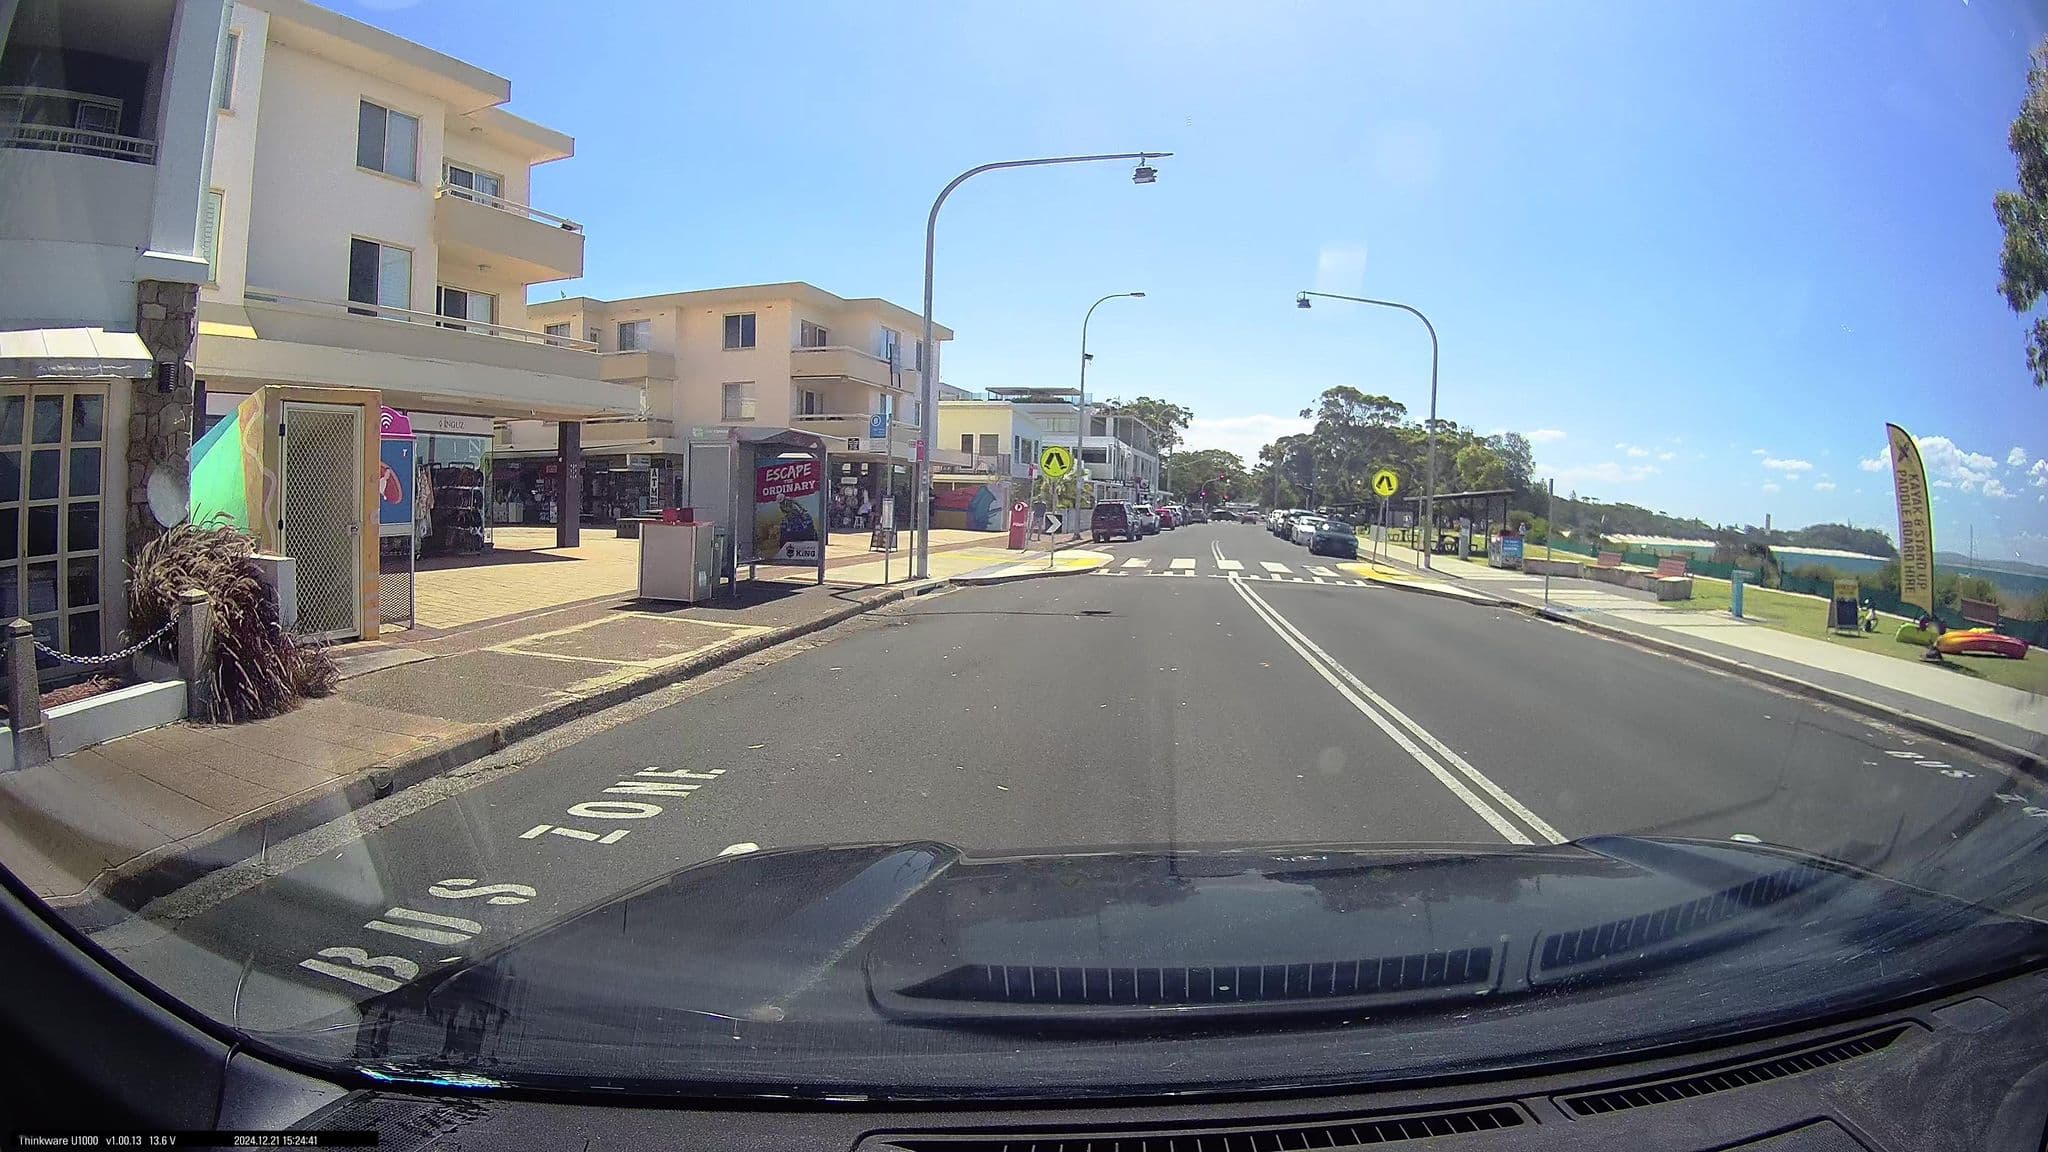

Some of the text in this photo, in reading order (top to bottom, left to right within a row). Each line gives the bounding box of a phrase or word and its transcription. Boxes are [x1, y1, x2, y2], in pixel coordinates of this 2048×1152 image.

[762, 480, 816, 497] ORDINARY
[766, 463, 812, 482] ESCAPE
[1909, 474, 1923, 514] KAYAK
[1897, 470, 1916, 592] PADDLE BOARD HIRE
[1915, 531, 1927, 569] STAND
[1917, 574, 1928, 589] UP
[298, 766, 727, 993] BUS ZONE
